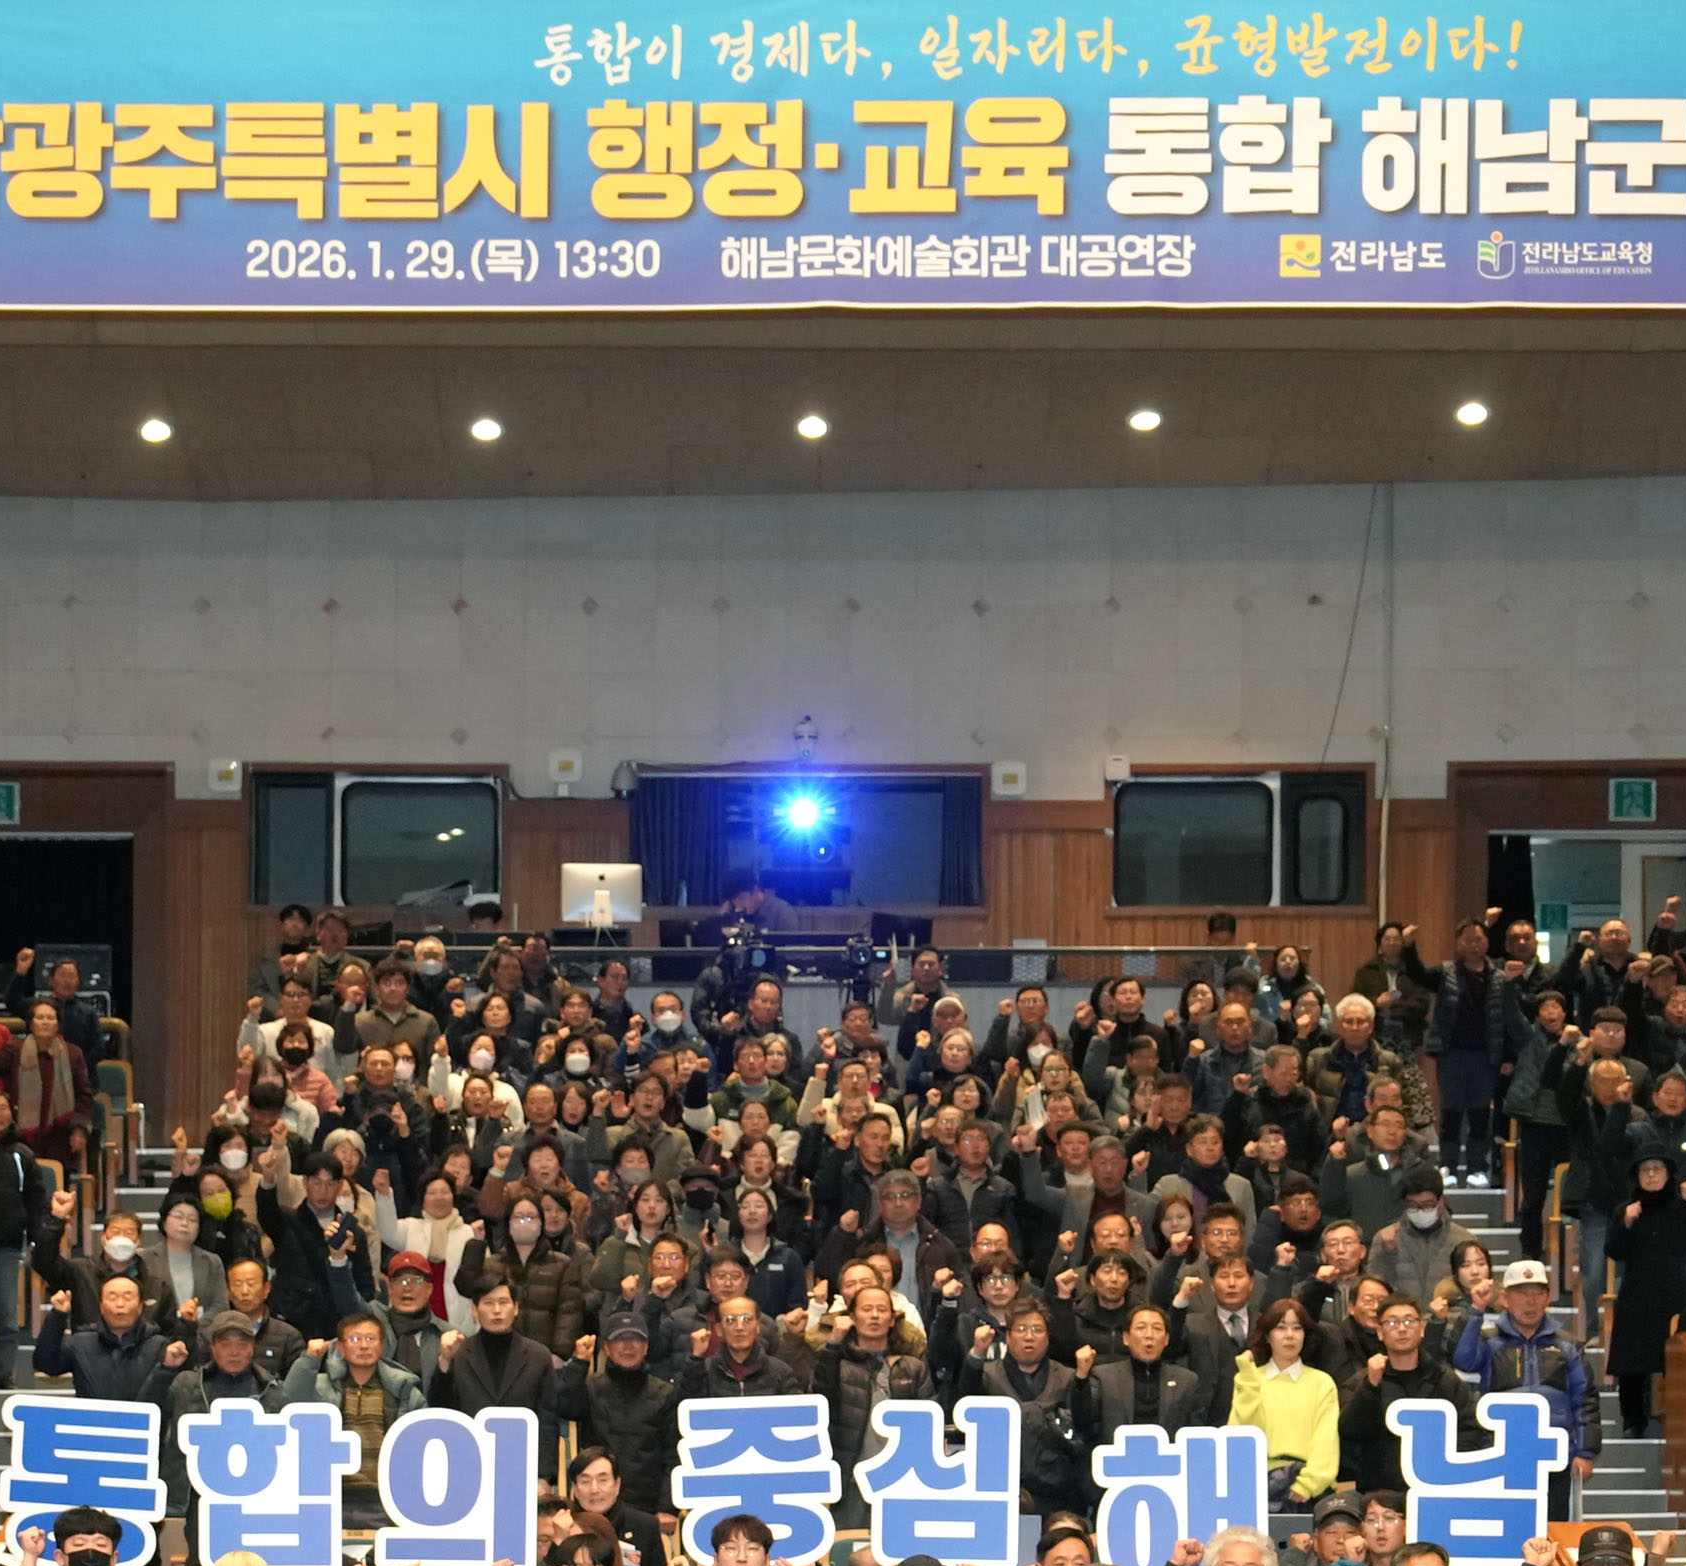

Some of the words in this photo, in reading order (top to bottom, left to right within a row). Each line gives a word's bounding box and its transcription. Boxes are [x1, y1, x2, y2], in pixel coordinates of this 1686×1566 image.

[534, 21, 683, 86] 통합이
[710, 19, 892, 83] 경제다,
[919, 14, 1150, 81] 일자리다,
[1175, 12, 1523, 79] 균형발전이다!
[587, 97, 1070, 219] 행정·교육
[1104, 94, 1333, 215] 통합
[246, 239, 357, 280] 2026.
[554, 239, 661, 279] 13:30
[720, 234, 1032, 280] 해남문화예술회관
[1040, 234, 1197, 279] 대공연장
[1329, 240, 1447, 273] 전라남도
[1522, 241, 1653, 265] 전라남도교육청
[680, 1403, 1011, 1563] 중심
